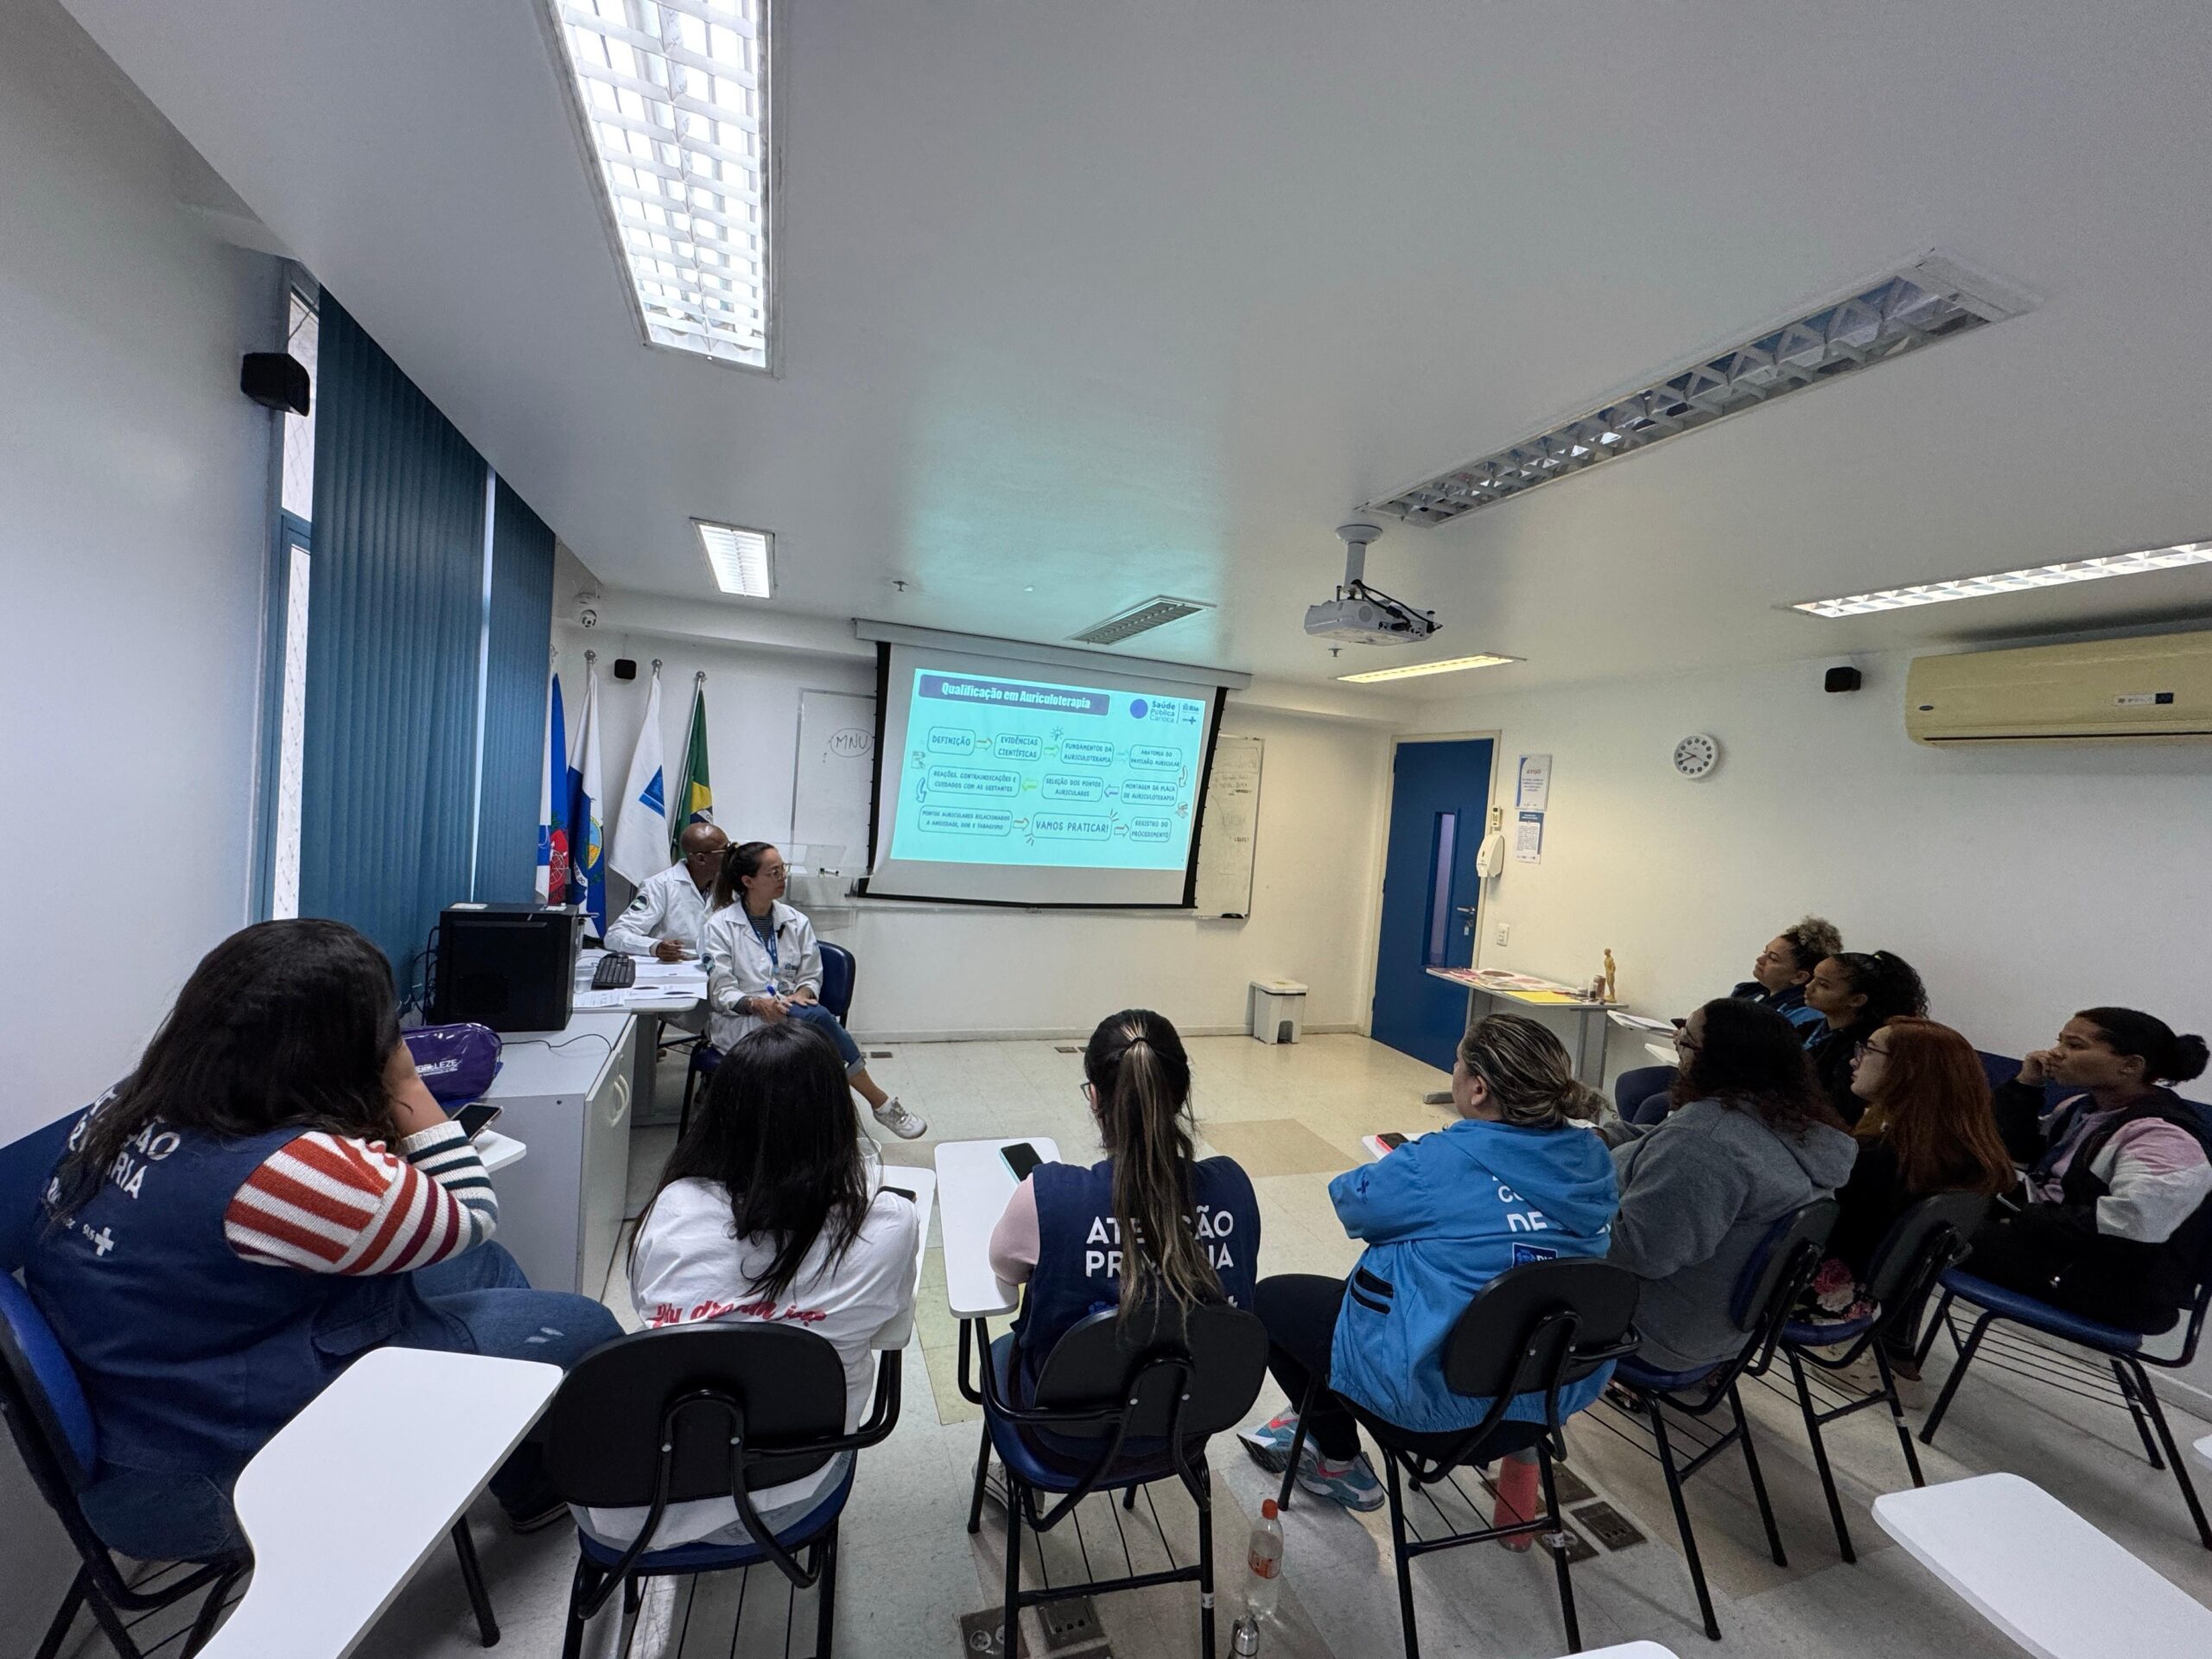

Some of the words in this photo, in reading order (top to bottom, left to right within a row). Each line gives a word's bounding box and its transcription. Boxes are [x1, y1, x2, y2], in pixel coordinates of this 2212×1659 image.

[942, 682, 1002, 700] Qualificação
[1003, 690, 1020, 702] em
[1019, 690, 1091, 709] Auriculoterapia
[1152, 701, 1176, 710] Saúde
[1150, 709, 1175, 717] Pública
[1149, 715, 1174, 723] Carioca
[931, 735, 971, 747] DEFINIÇÃO
[1001, 736, 1039, 747] EVIDÊNCIAS
[1065, 743, 1103, 752] FUNDAMENTOS
[998, 747, 1038, 759] CIENTÍFICAS
[1064, 753, 1111, 763] AURICULOTERAPIA
[960, 772, 1012, 783] CONTRAINDICAÇÕES
[1046, 778, 1068, 786] SELEÇÃO
[1125, 783, 1151, 791] MONTAGEM
[1132, 793, 1175, 802] AURICULOTERAPIA
[1036, 821, 1064, 831] VAMOS
[1067, 822, 1109, 833] PRATICAR!
[1086, 1205, 1234, 1245] ATEÃO
[1085, 1242, 1234, 1279] PRIA
